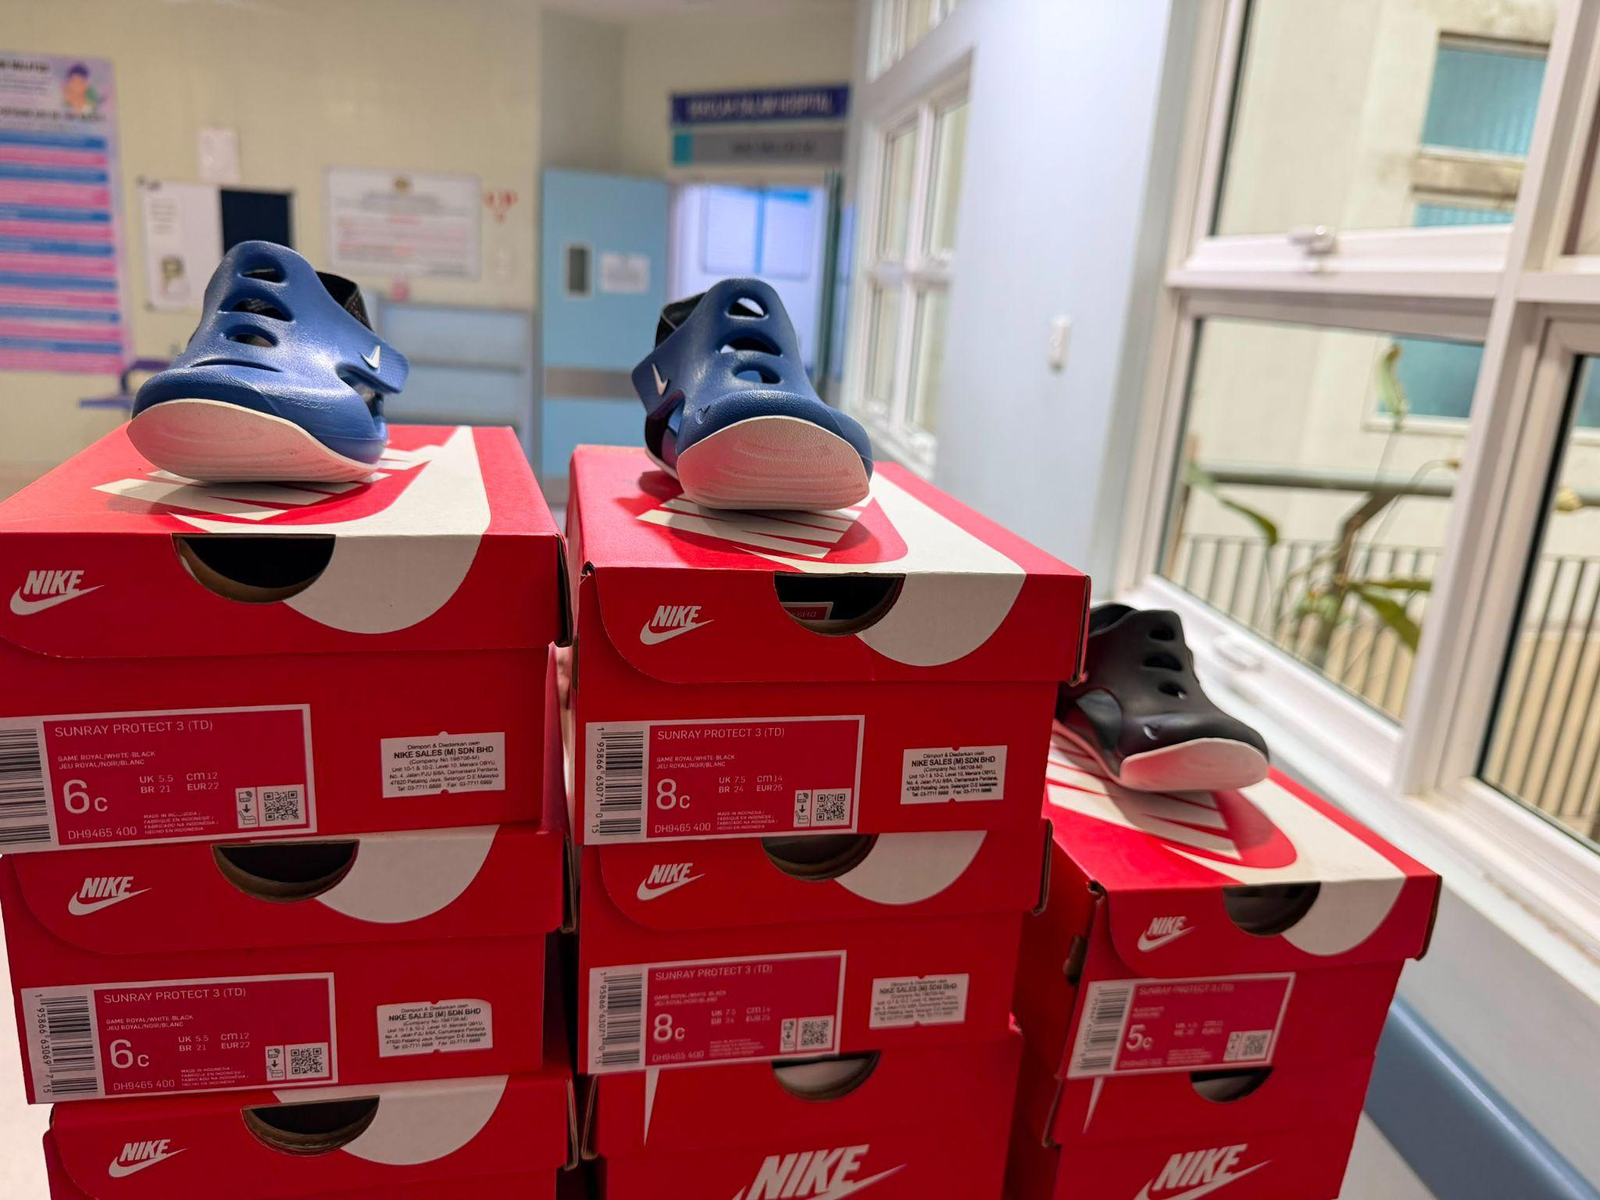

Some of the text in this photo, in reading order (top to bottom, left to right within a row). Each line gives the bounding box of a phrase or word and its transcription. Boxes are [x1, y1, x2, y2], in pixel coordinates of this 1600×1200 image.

[23, 570, 85, 595] NIKE
[650, 605, 702, 627] NIKE
[54, 719, 213, 738] SUNRAY PROTECT 3 (TD)
[657, 727, 785, 740] SUNRAY PROTECT 3 (TD)
[58, 755, 78, 763] GAME
[393, 745, 494, 759] NIKE SALES (M) SDN BHD
[596, 741, 605, 771] 95866
[911, 759, 928, 767] NIKE
[930, 758, 952, 766] SALES
[965, 756, 979, 764] SDN
[980, 755, 996, 763] BHD
[139, 776, 154, 784] UK
[158, 774, 174, 783] 5.5
[734, 775, 746, 784] 7.5
[140, 786, 155, 794] BR
[159, 785, 171, 793] 21
[595, 775, 605, 802] 63071
[718, 786, 730, 794] BR
[733, 785, 744, 793] 24
[68, 826, 137, 840] DH9465 400
[654, 822, 711, 834] DH9465 400
[647, 862, 693, 884] NIKE
[79, 876, 134, 898] NIKE
[1146, 915, 1187, 936] NIKE
[655, 964, 773, 981] SUNRAY PROTECT 3 (TD)
[104, 987, 246, 1004] SUNRAY PROTECT 3 (TD)
[447, 1009, 463, 1017] SDN
[465, 1007, 481, 1015] BHD
[36, 1007, 47, 1035] 95866
[40, 1039, 52, 1065] 63069
[113, 1079, 175, 1091] DH9465 400
[119, 1138, 171, 1162] NIKE
[745, 1143, 870, 1200] NIKE
[1151, 1143, 1248, 1191] NIKE
